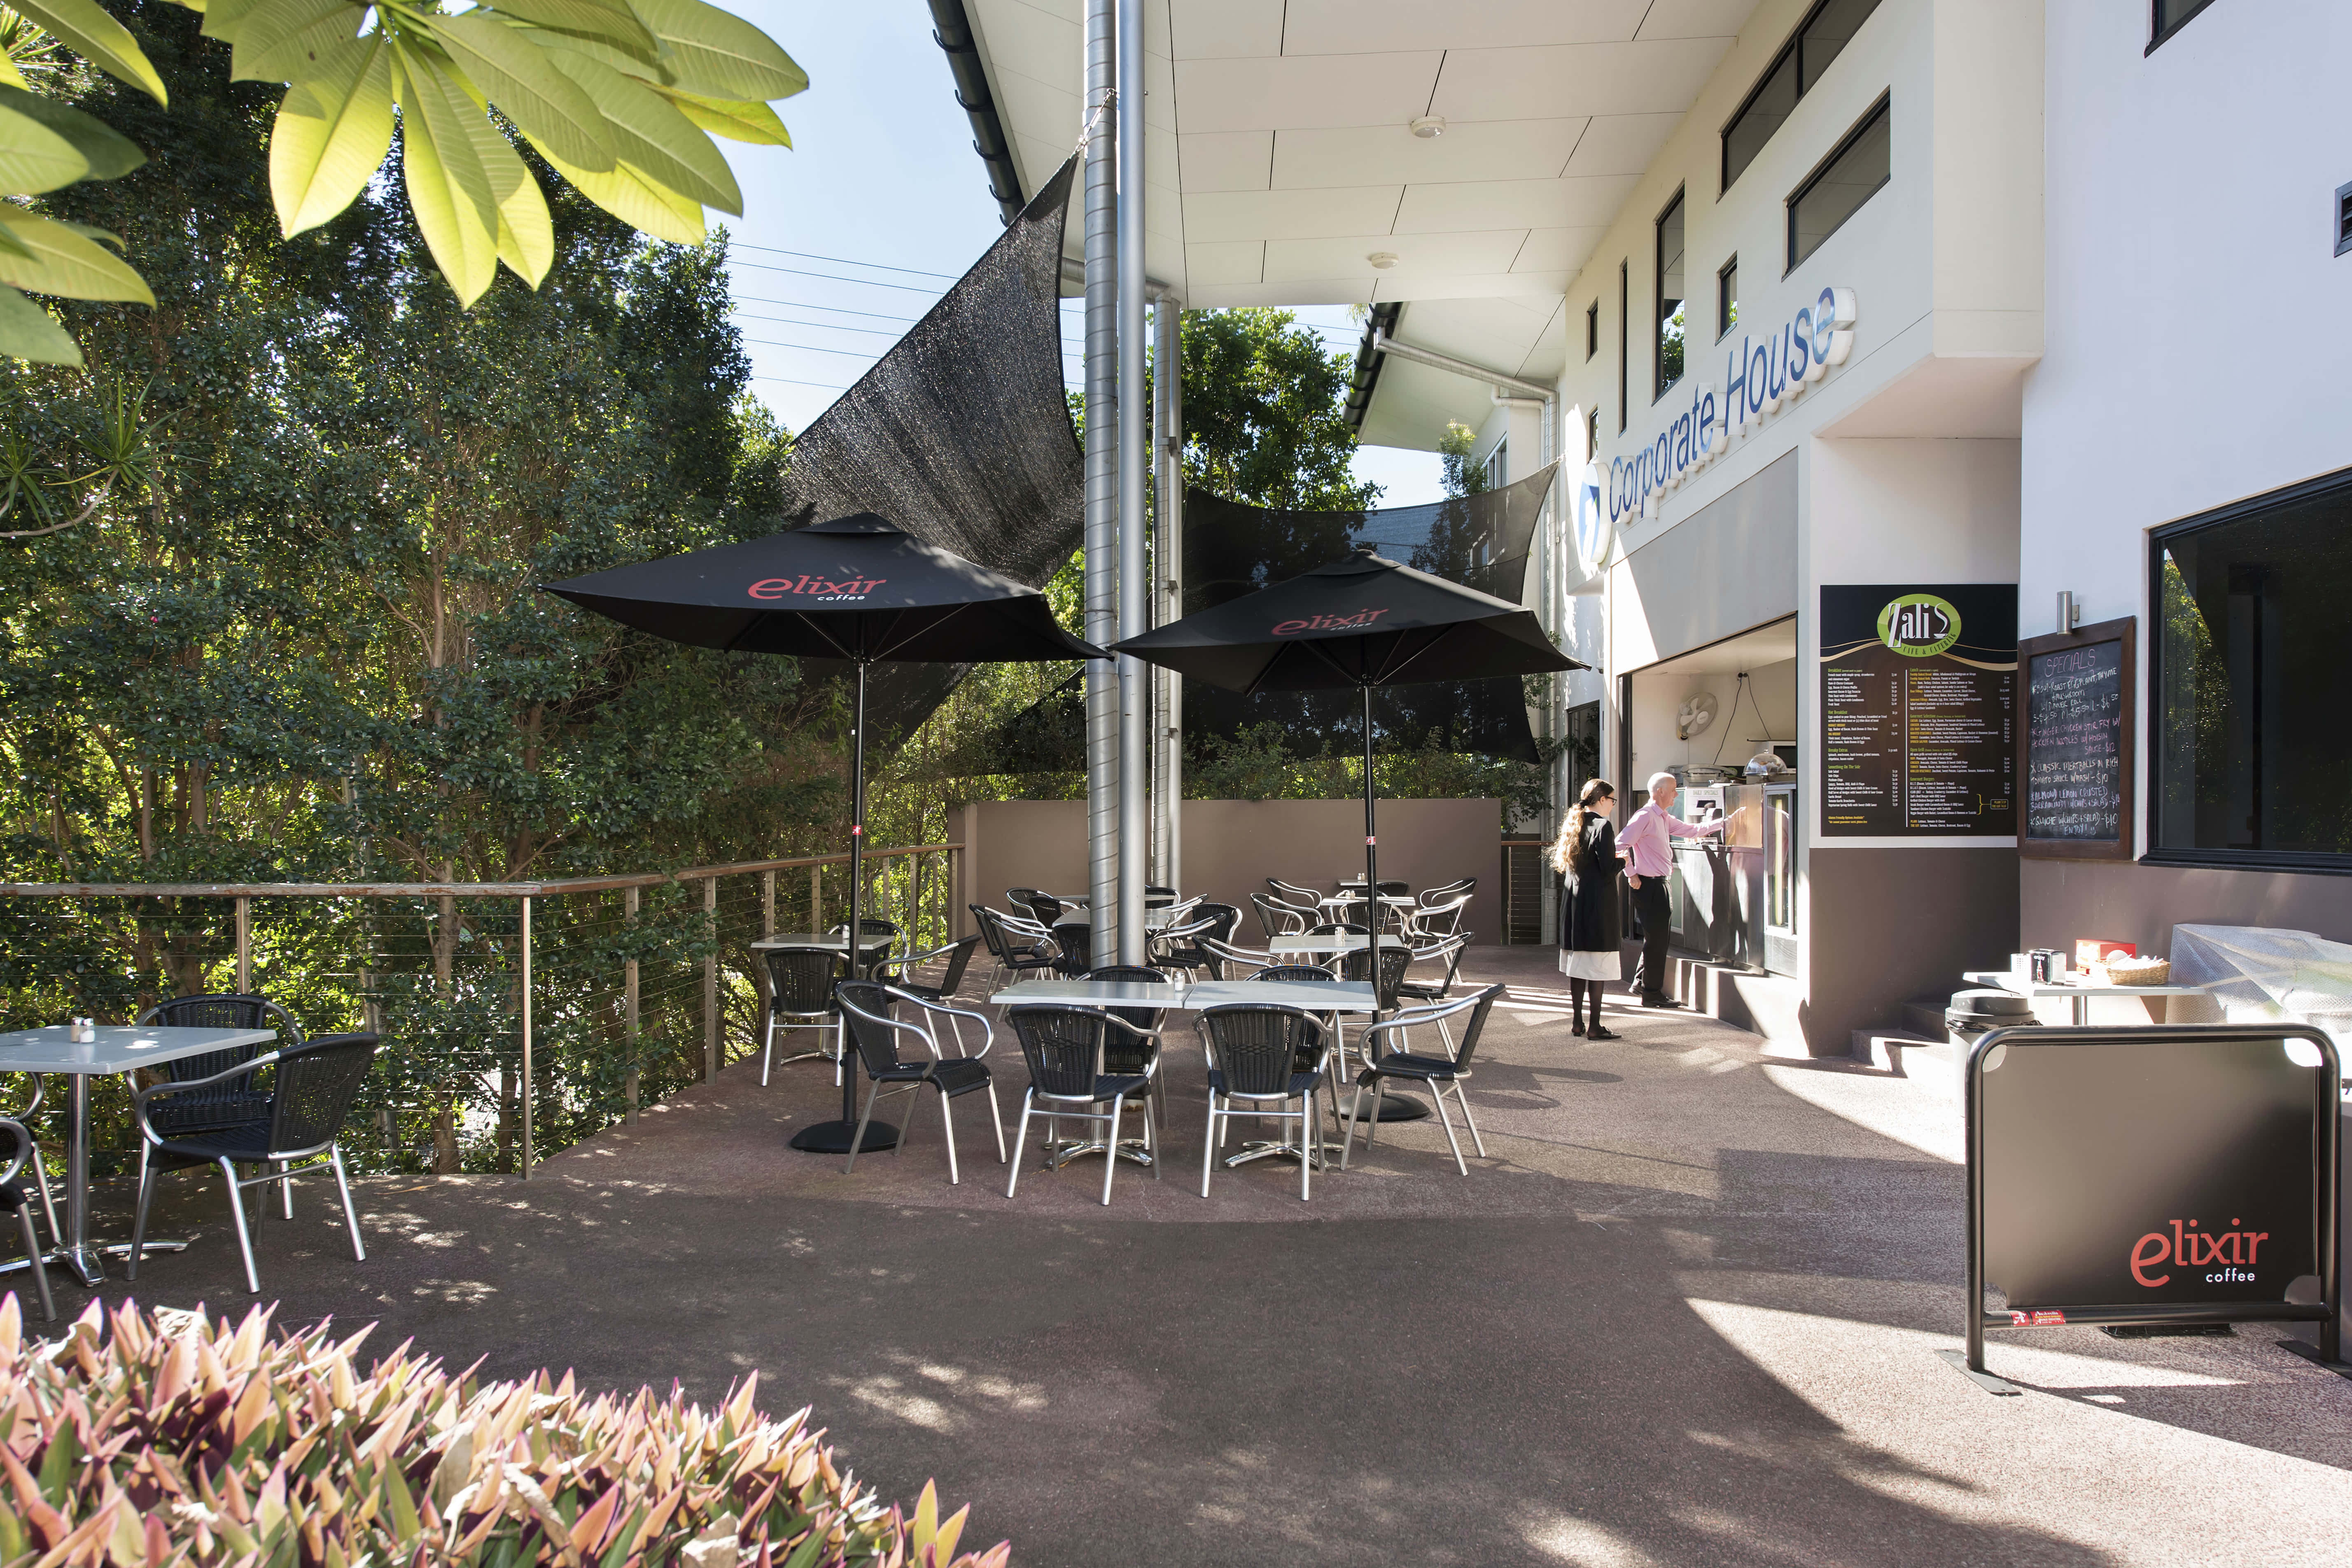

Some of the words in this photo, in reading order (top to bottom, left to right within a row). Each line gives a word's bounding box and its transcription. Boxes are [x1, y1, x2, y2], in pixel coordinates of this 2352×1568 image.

[1610, 385, 1715, 523] Corporate
[1724, 287, 1835, 436] House
[748, 575, 887, 600] elixir
[1272, 608, 1389, 635] elixir
[1330, 622, 1372, 631] coffee
[2045, 649, 2095, 677] SPECIALS
[2060, 723, 2082, 733] CHICKEN
[2084, 722, 2098, 731] STIR
[2099, 719, 2109, 728] FRY
[2037, 762, 2061, 772] CLASSIC
[2064, 759, 2095, 771] MEATBALLS
[2106, 756, 2118, 768] RICH
[2031, 776, 2051, 785] TOMATO
[2053, 774, 2068, 782] SAUCE
[2059, 789, 2077, 798] LEMON
[2080, 786, 2108, 798] CRUSTED
[2130, 1218, 2268, 1287] elixir
[2206, 1267, 2255, 1283] coffee
